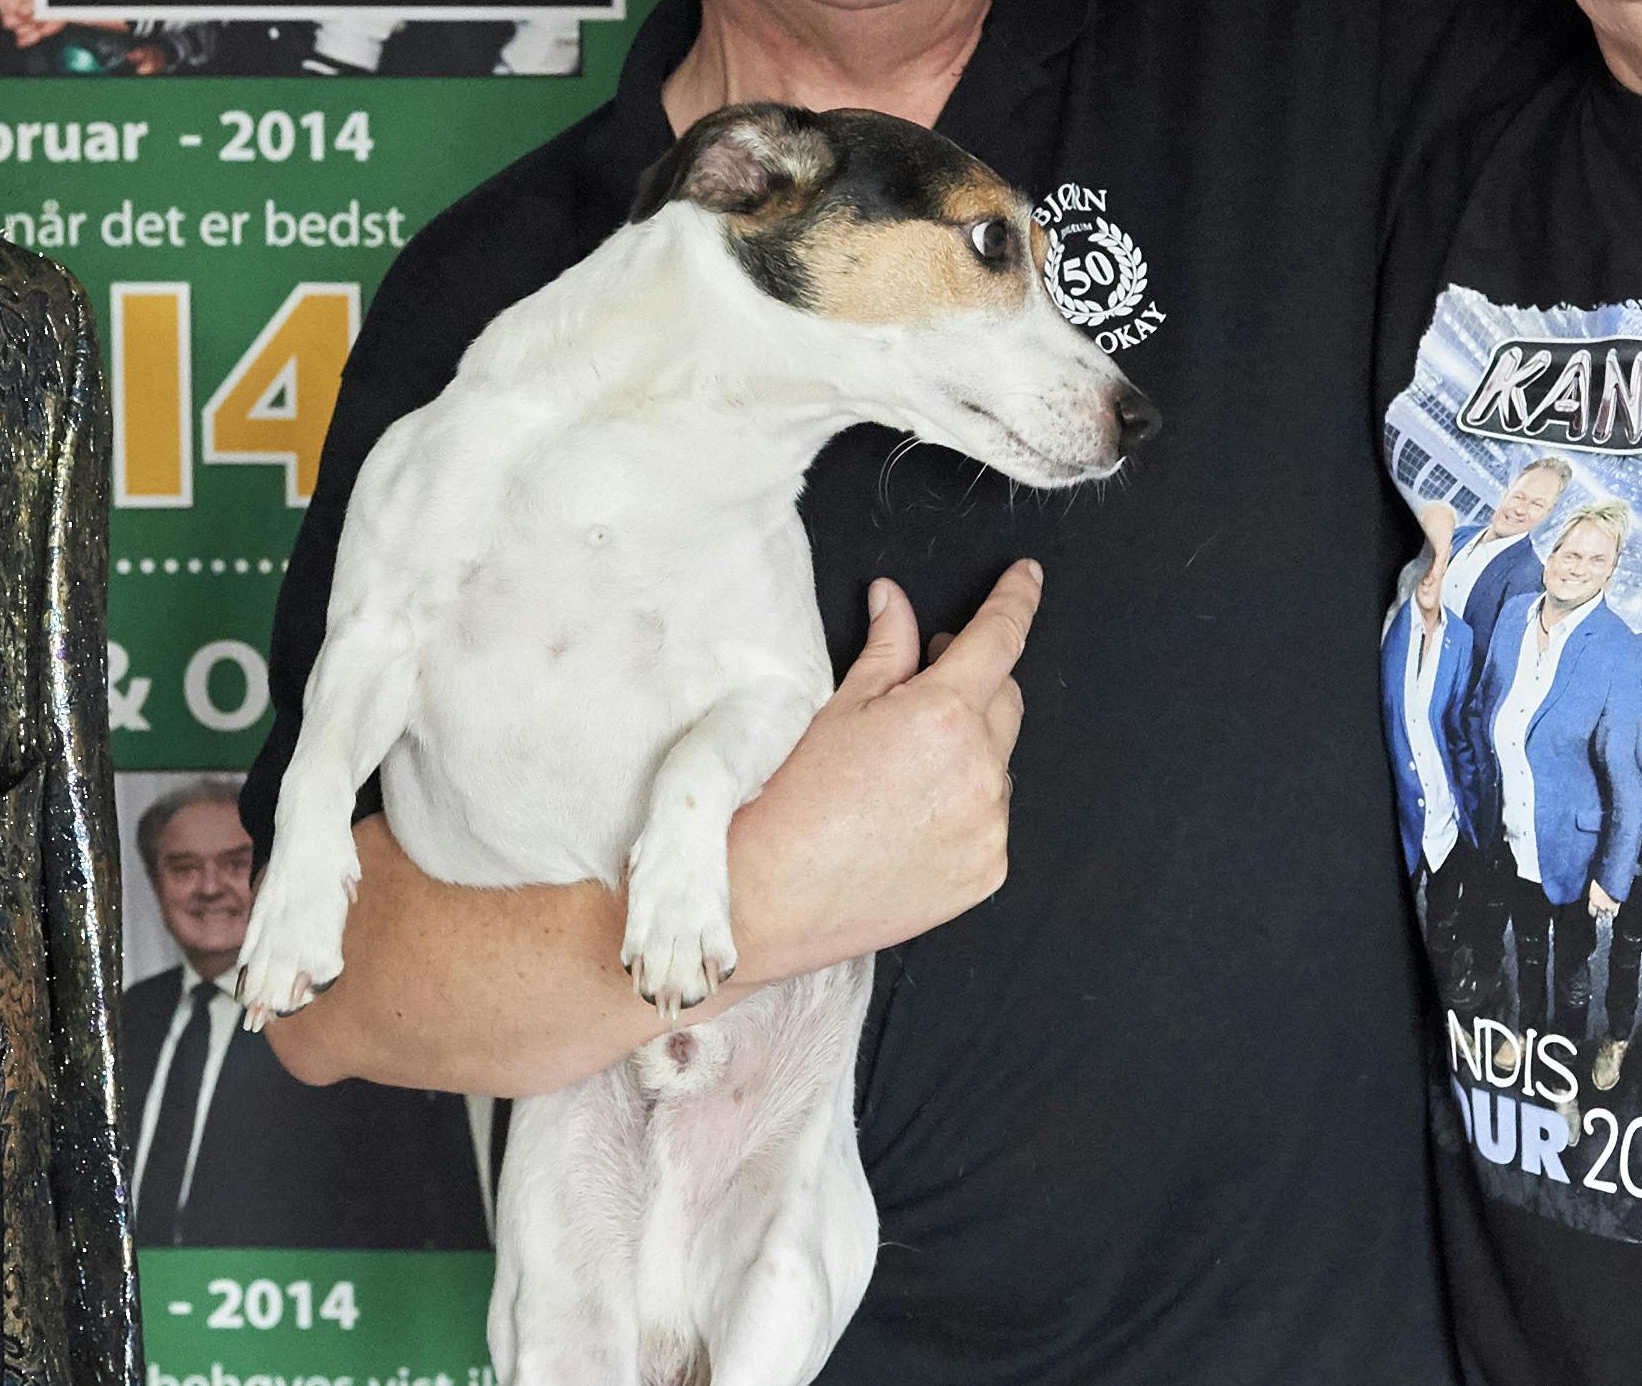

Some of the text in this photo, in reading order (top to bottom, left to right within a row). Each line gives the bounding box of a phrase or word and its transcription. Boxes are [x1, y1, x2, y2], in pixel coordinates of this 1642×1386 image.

[218, 109, 375, 163] 2014
[0, 199, 88, 248] når
[100, 198, 187, 248] det
[198, 210, 251, 248] er
[1062, 250, 1115, 297] 50
[1095, 300, 1167, 354] OKAY
[206, 1277, 362, 1331] 2014
